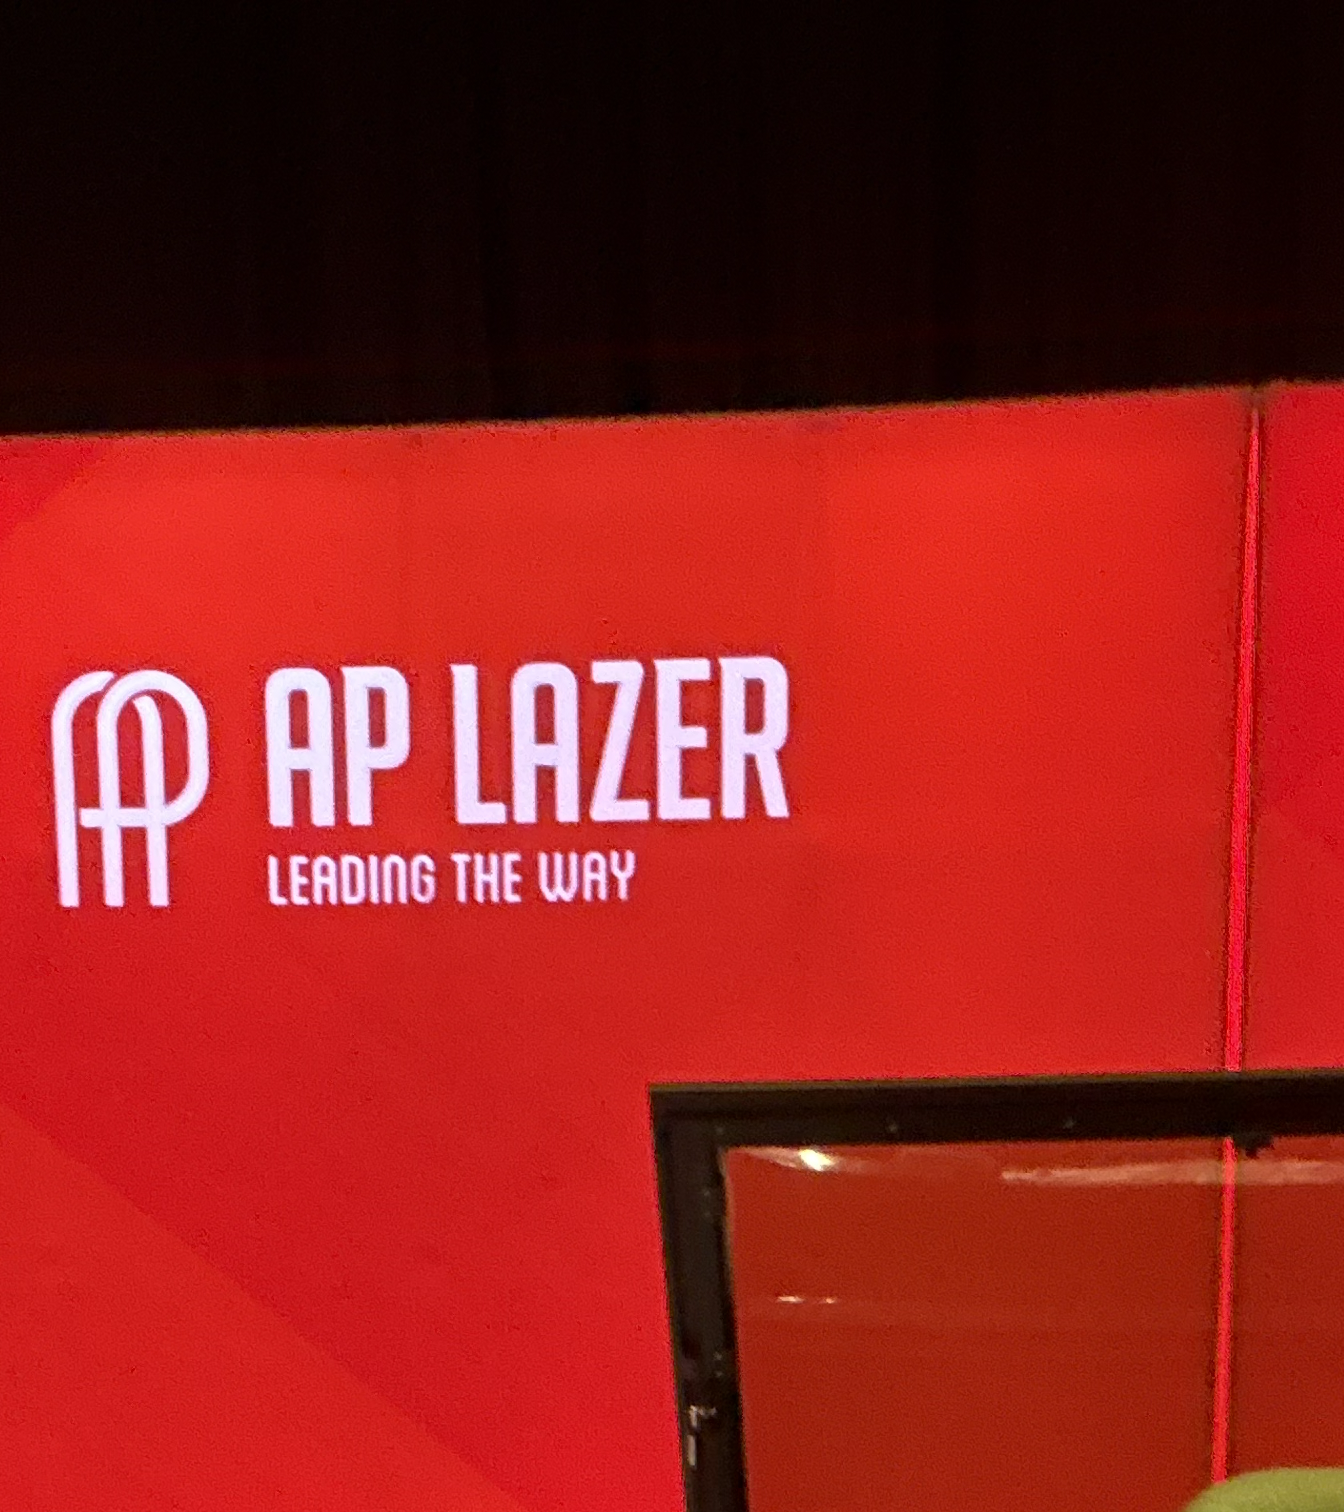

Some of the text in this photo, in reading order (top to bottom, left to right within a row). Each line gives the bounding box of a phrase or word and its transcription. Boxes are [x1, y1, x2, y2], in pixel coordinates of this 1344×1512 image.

[264, 656, 790, 828] AP LAZER
[267, 851, 637, 906] LEADING THE WAY
